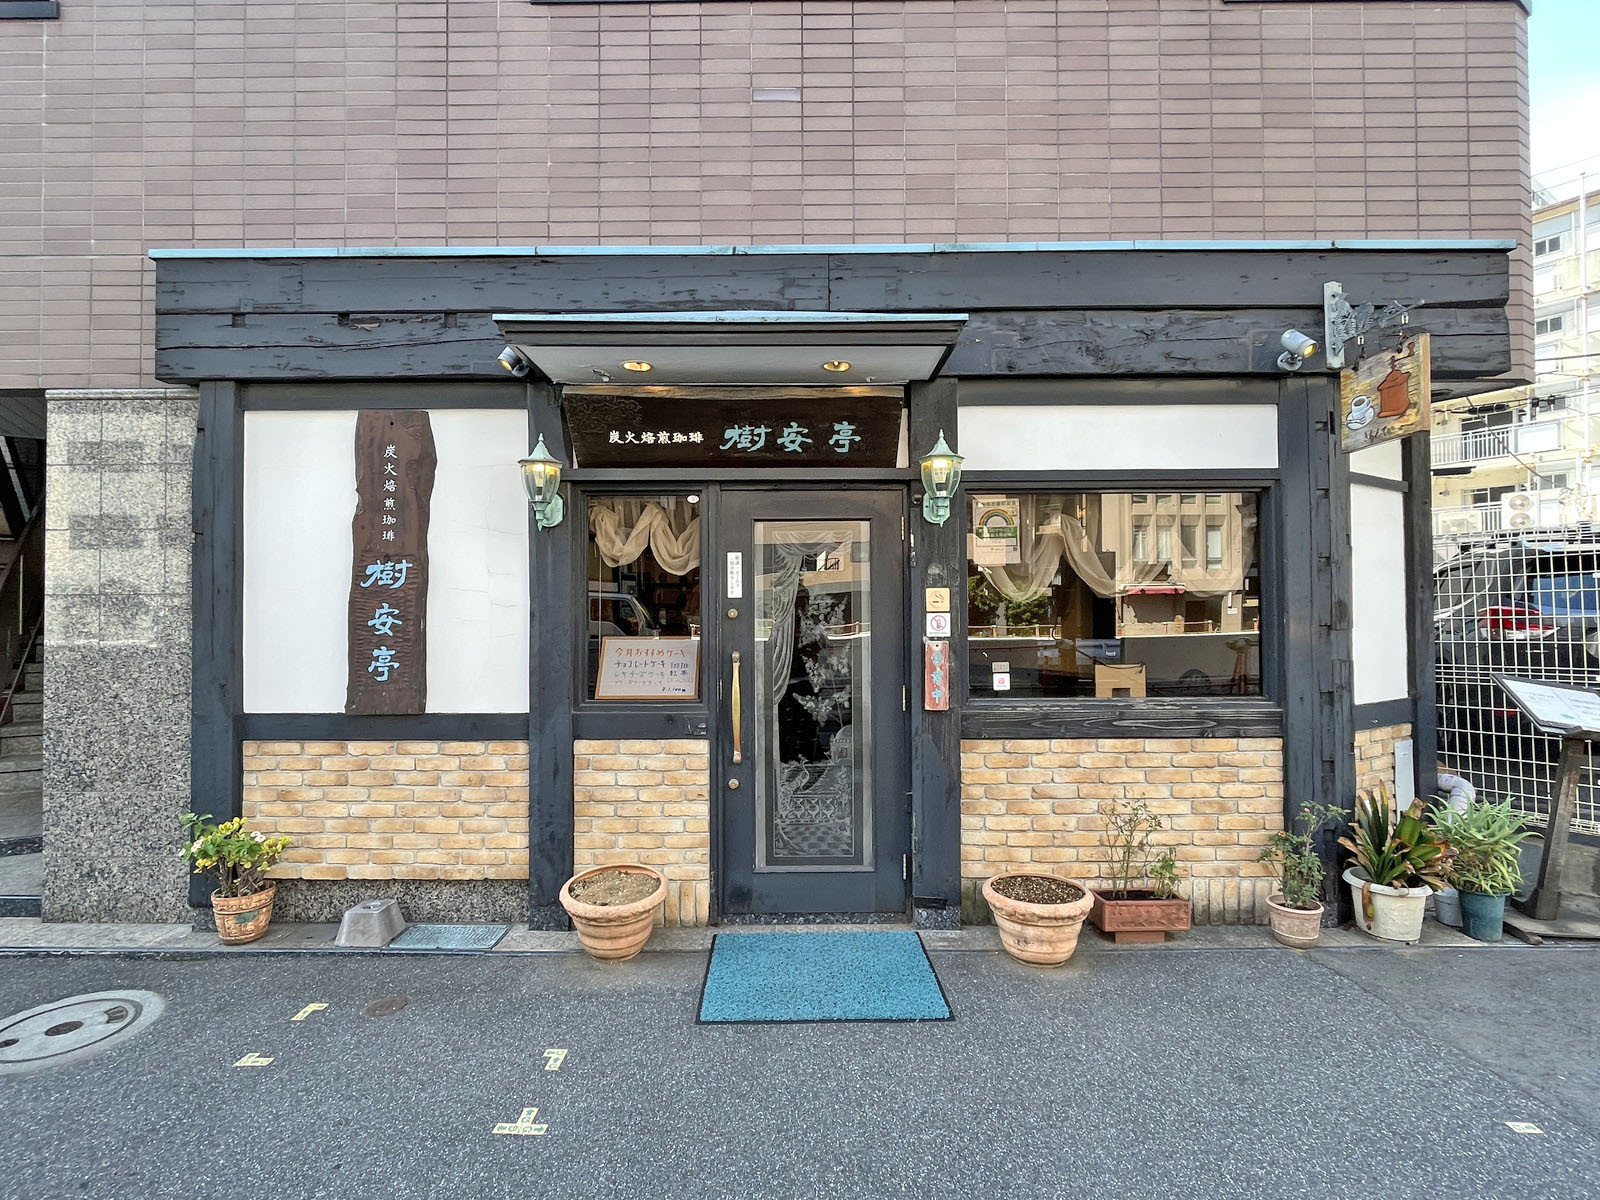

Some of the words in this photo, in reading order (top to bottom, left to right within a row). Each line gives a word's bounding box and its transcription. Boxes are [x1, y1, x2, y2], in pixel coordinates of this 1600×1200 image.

[608, 429, 704, 445] 炭火焙煎珈琲
[719, 420, 862, 453] 樹安亭
[381, 444, 398, 542] 炭火焙煎珈琲
[359, 559, 414, 682] 樹安亭
